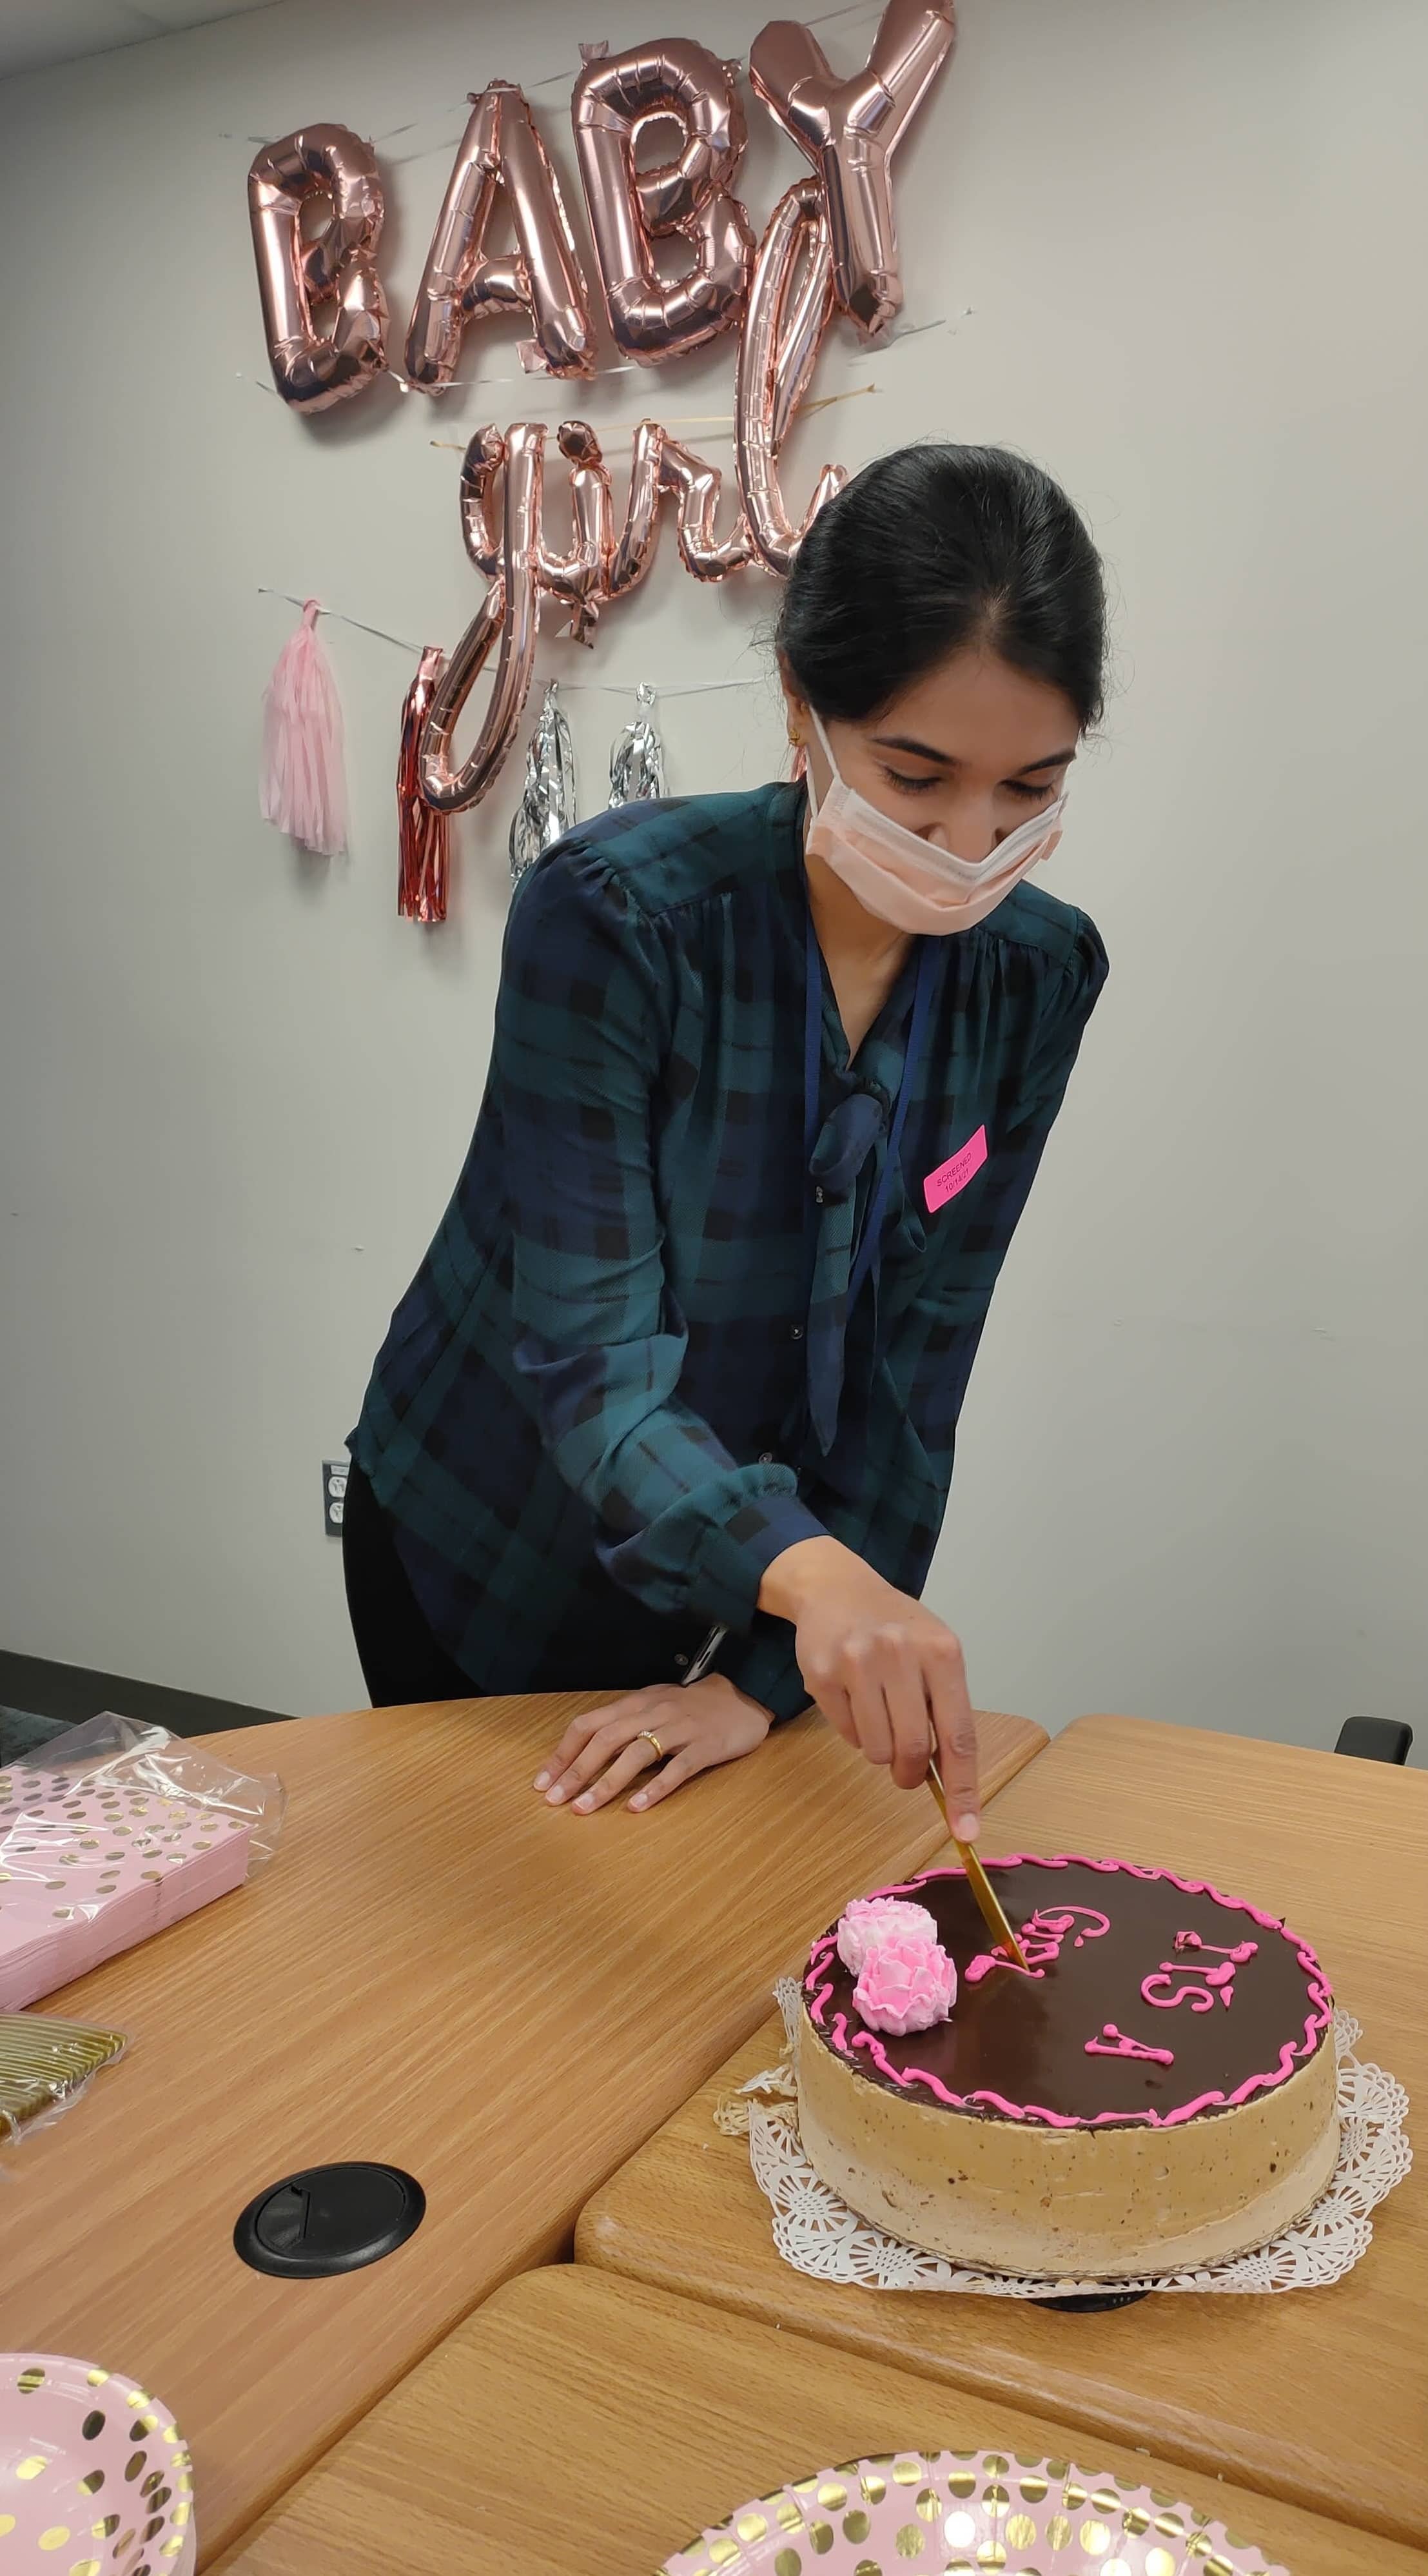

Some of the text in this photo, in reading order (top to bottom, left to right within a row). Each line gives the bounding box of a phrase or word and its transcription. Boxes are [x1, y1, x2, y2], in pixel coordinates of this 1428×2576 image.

[248, 0, 955, 415] BABY
[420, 177, 848, 815] girl
[937, 1152, 972, 1186] SCREENED
[1084, 2024, 1175, 2065] A
